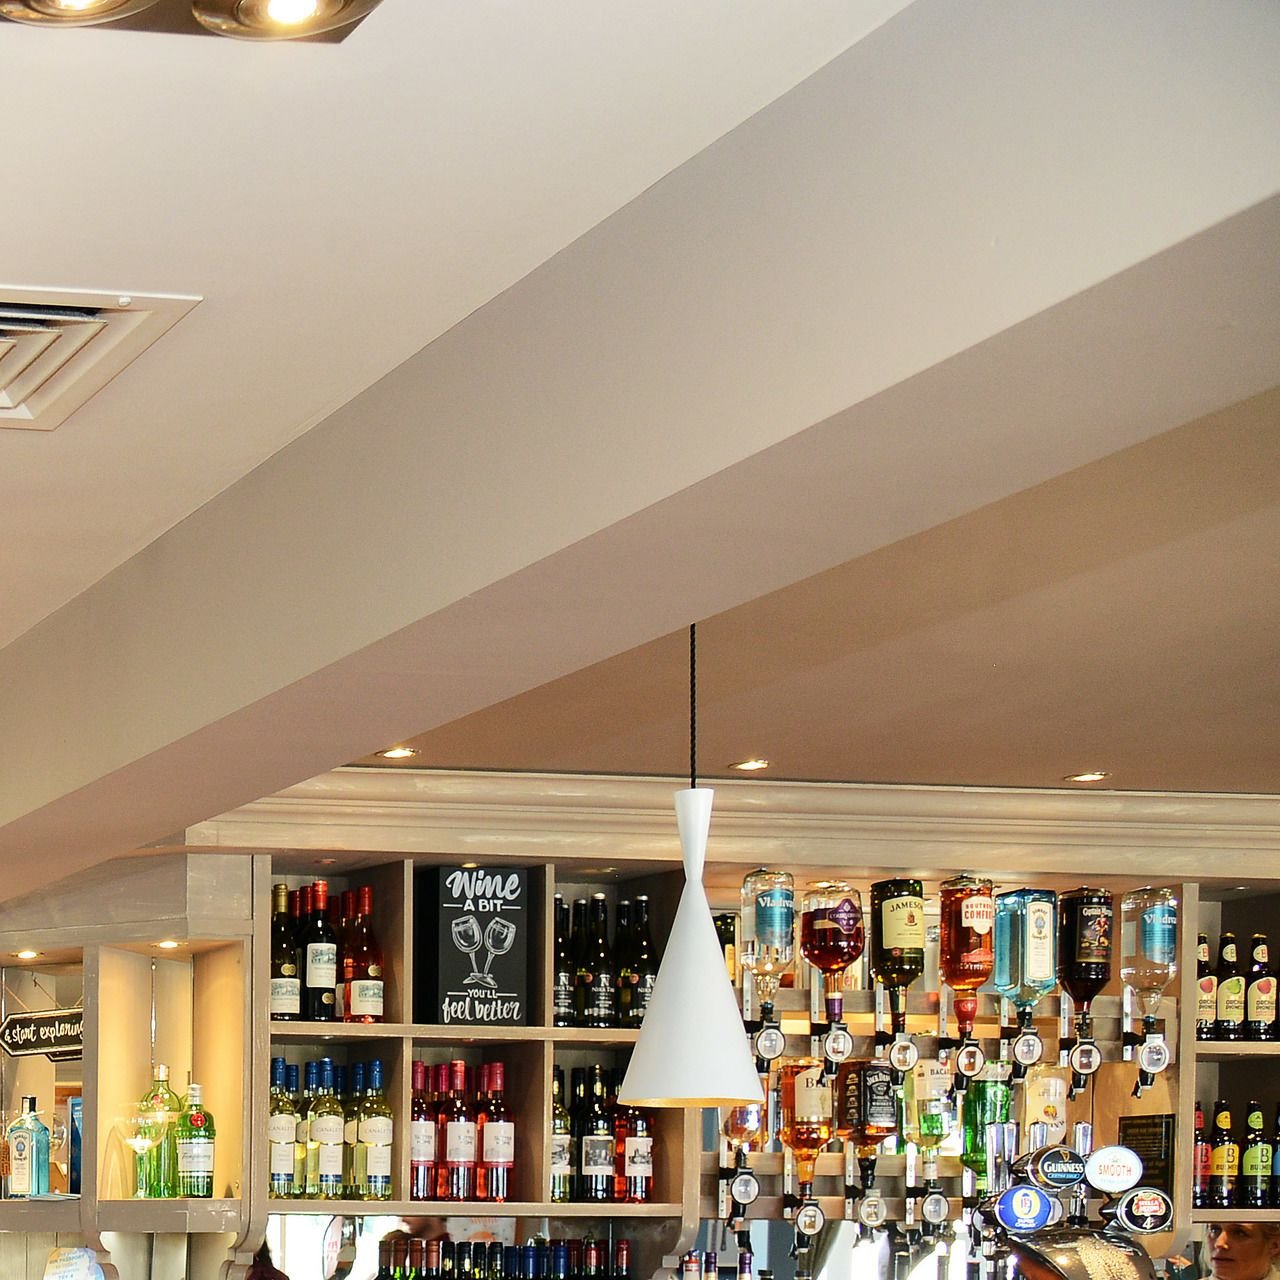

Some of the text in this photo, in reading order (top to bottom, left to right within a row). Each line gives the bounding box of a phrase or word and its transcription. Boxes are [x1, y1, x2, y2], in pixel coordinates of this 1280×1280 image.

[445, 869, 521, 900] Wine
[463, 900, 503, 912] A BIT
[467, 989, 498, 998] YOU'LL
[442, 997, 521, 1023] feel better
[4, 1020, 83, 1044] & start exploring
[1043, 1161, 1084, 1173] GUINNESS
[1098, 1164, 1132, 1176] SMOOTH
